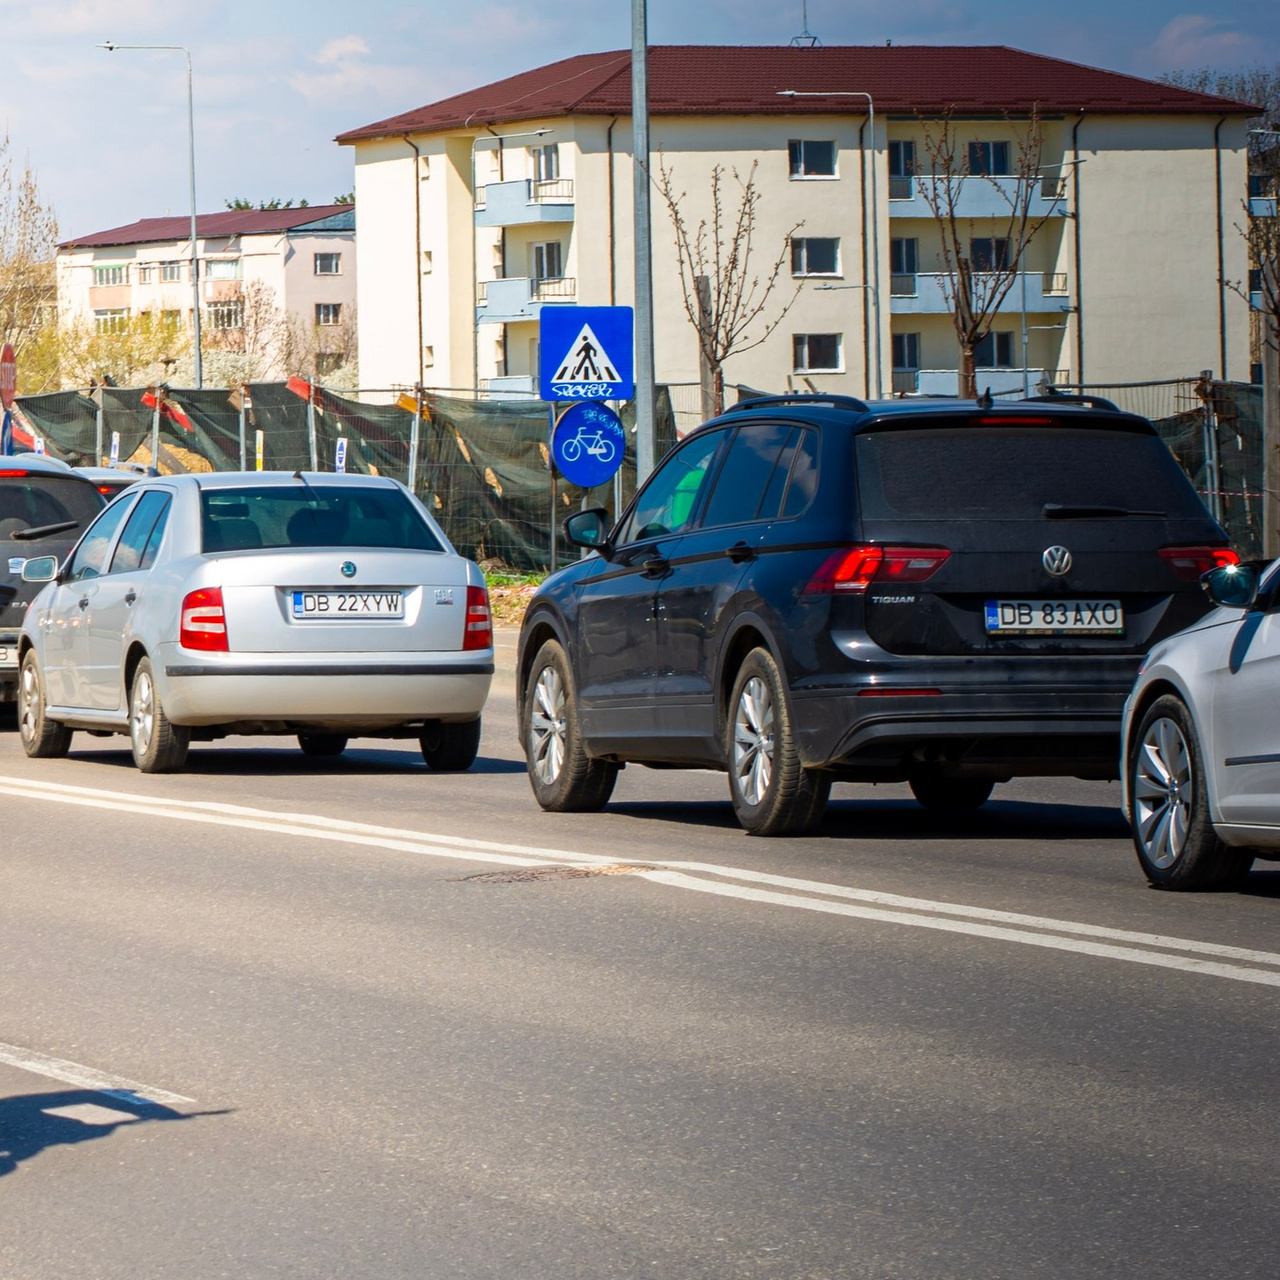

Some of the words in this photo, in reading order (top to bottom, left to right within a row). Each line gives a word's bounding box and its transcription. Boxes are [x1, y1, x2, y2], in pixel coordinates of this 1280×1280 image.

[304, 595, 329, 612] DB
[871, 596, 915, 604] TIGUAN
[1000, 602, 1033, 625] DB
